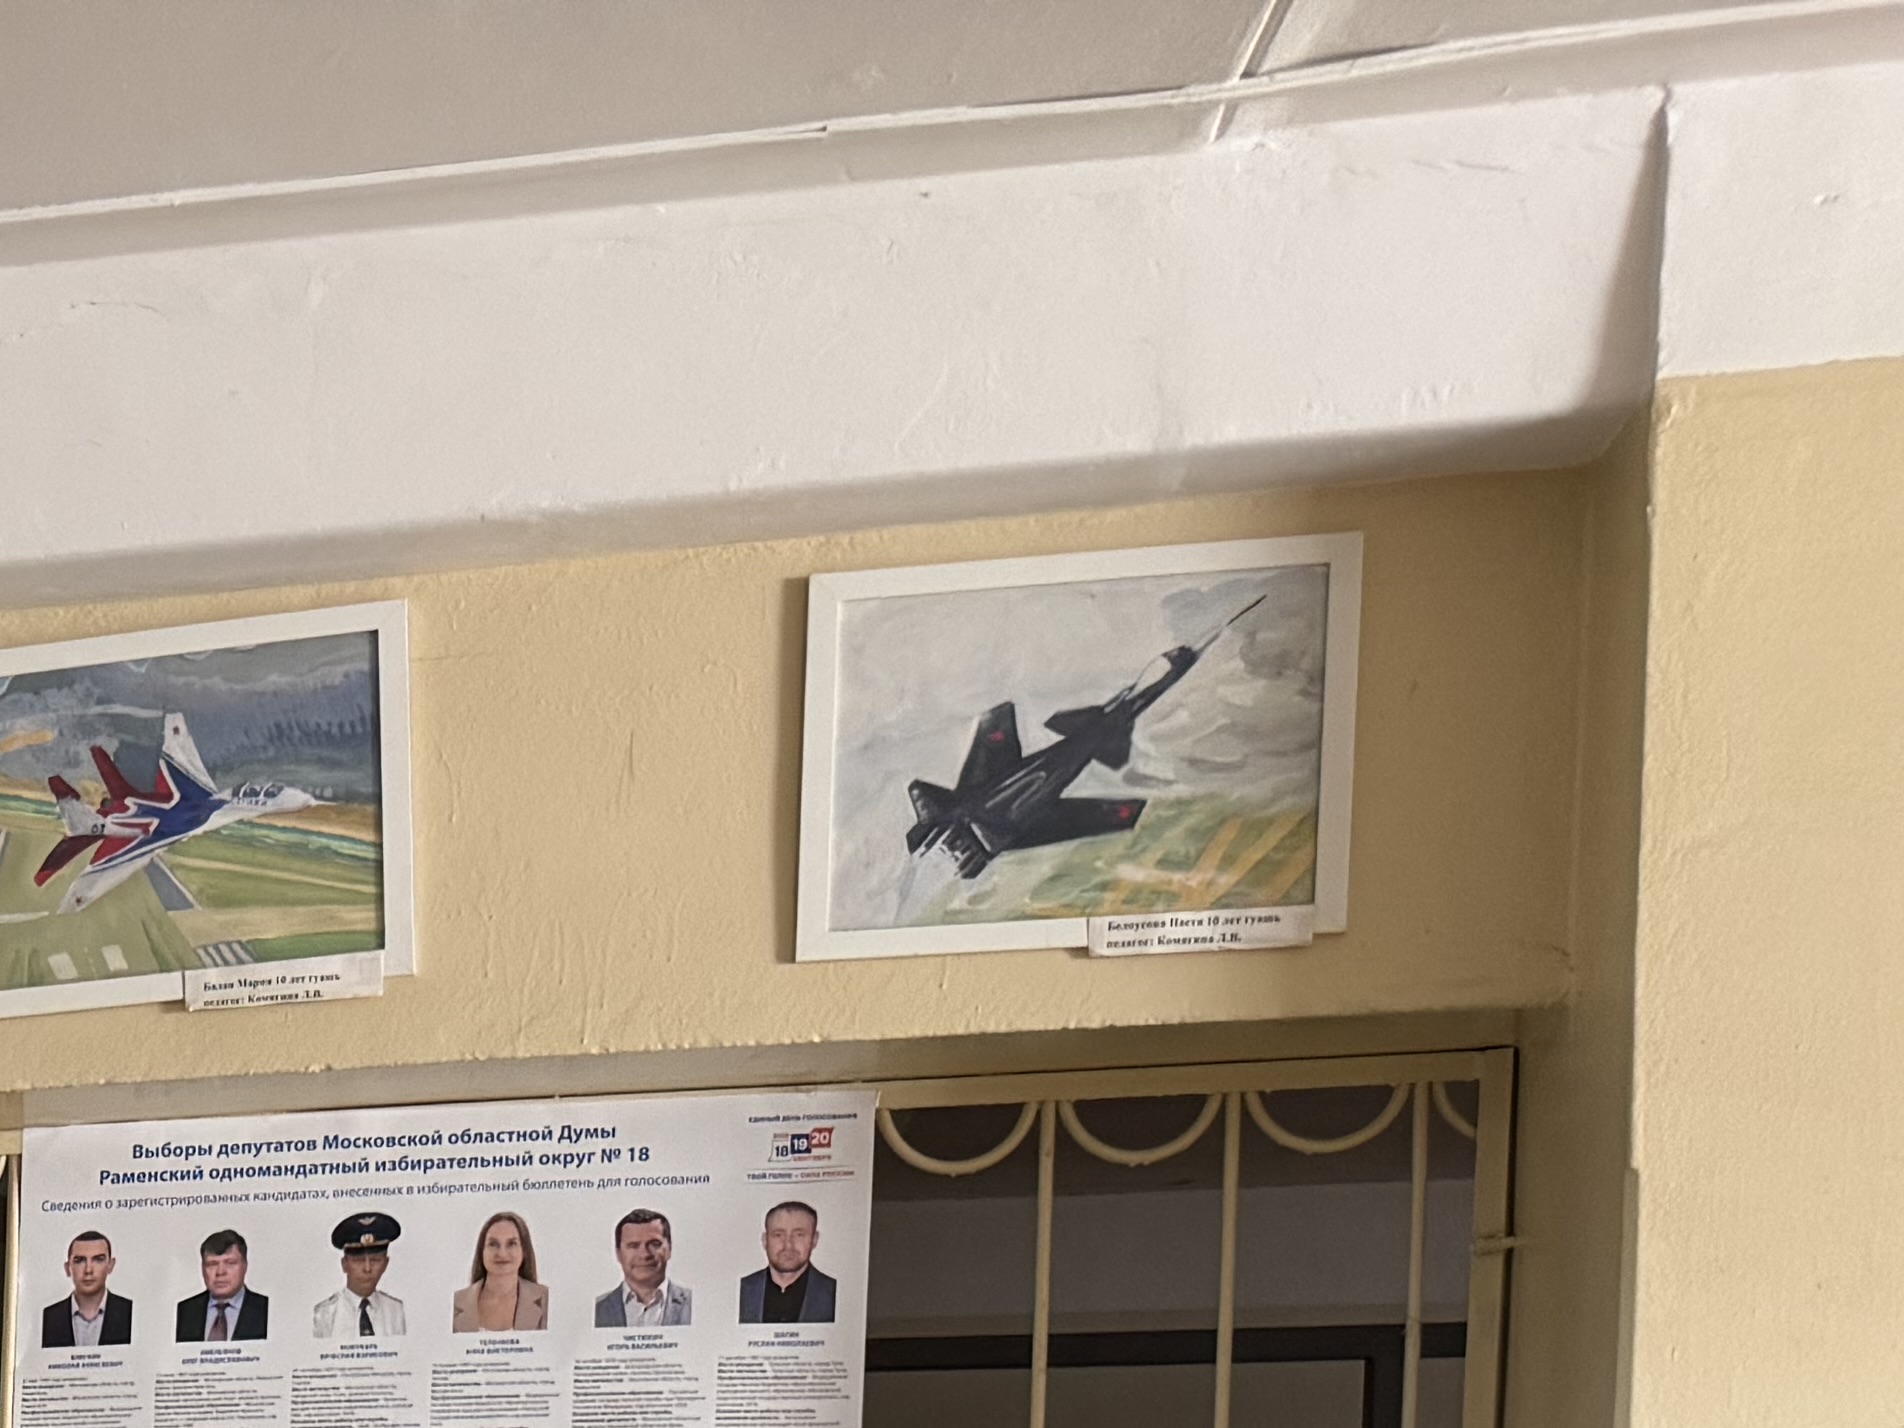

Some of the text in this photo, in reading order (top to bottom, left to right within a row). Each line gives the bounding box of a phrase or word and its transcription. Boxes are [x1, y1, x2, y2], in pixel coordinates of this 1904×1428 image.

[132, 1125, 616, 1163] Выборы депутатов Московской областной Думы
[775, 1132, 830, 1157] 18 19 20
[99, 1147, 650, 1186] Раменский одномандатный избирательный округ № 18
[41, 1198, 102, 1214] Сведения
[115, 1194, 250, 1212] зарегистрированных
[332, 1188, 404, 1200] внесенных
[416, 1181, 520, 1200] избирательный
[522, 1178, 594, 1193] бюллетень
[596, 1179, 622, 1191] для
[624, 1175, 710, 1189] голосования
